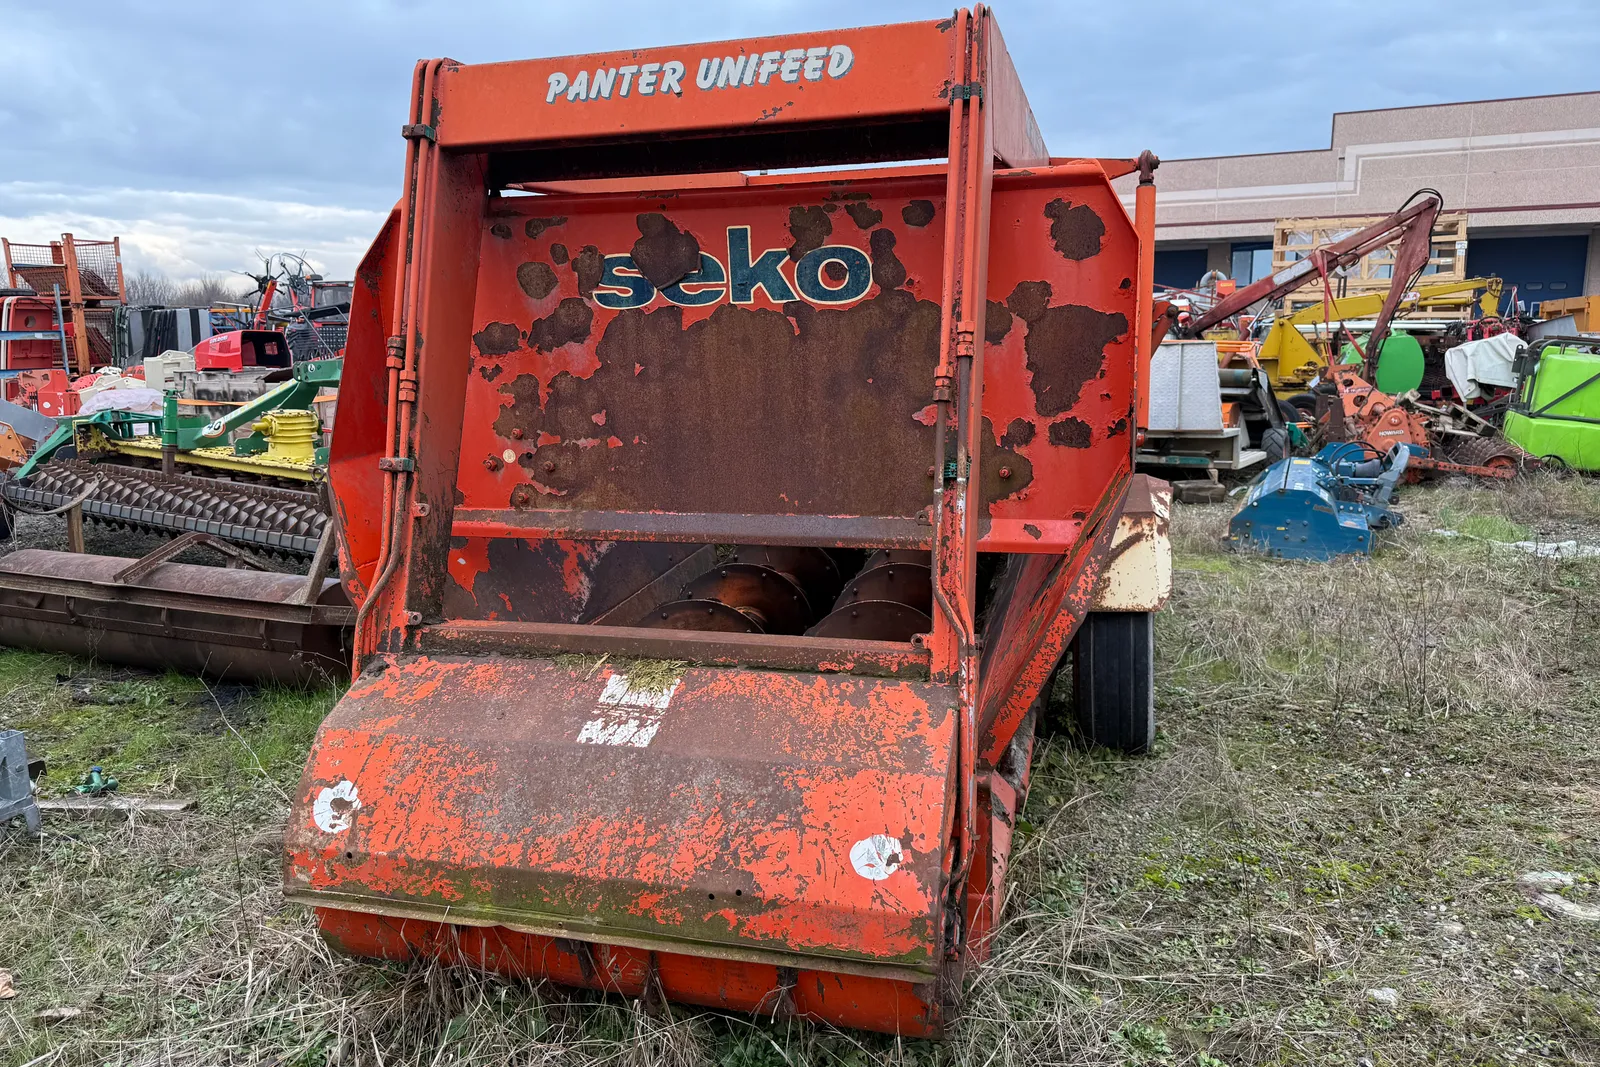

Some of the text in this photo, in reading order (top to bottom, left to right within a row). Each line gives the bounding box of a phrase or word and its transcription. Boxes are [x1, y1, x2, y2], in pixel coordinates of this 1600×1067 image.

[545, 44, 855, 104] PANTER UNIFEED
[592, 225, 874, 310] seko
[1378, 429, 1404, 437] HOWARD
